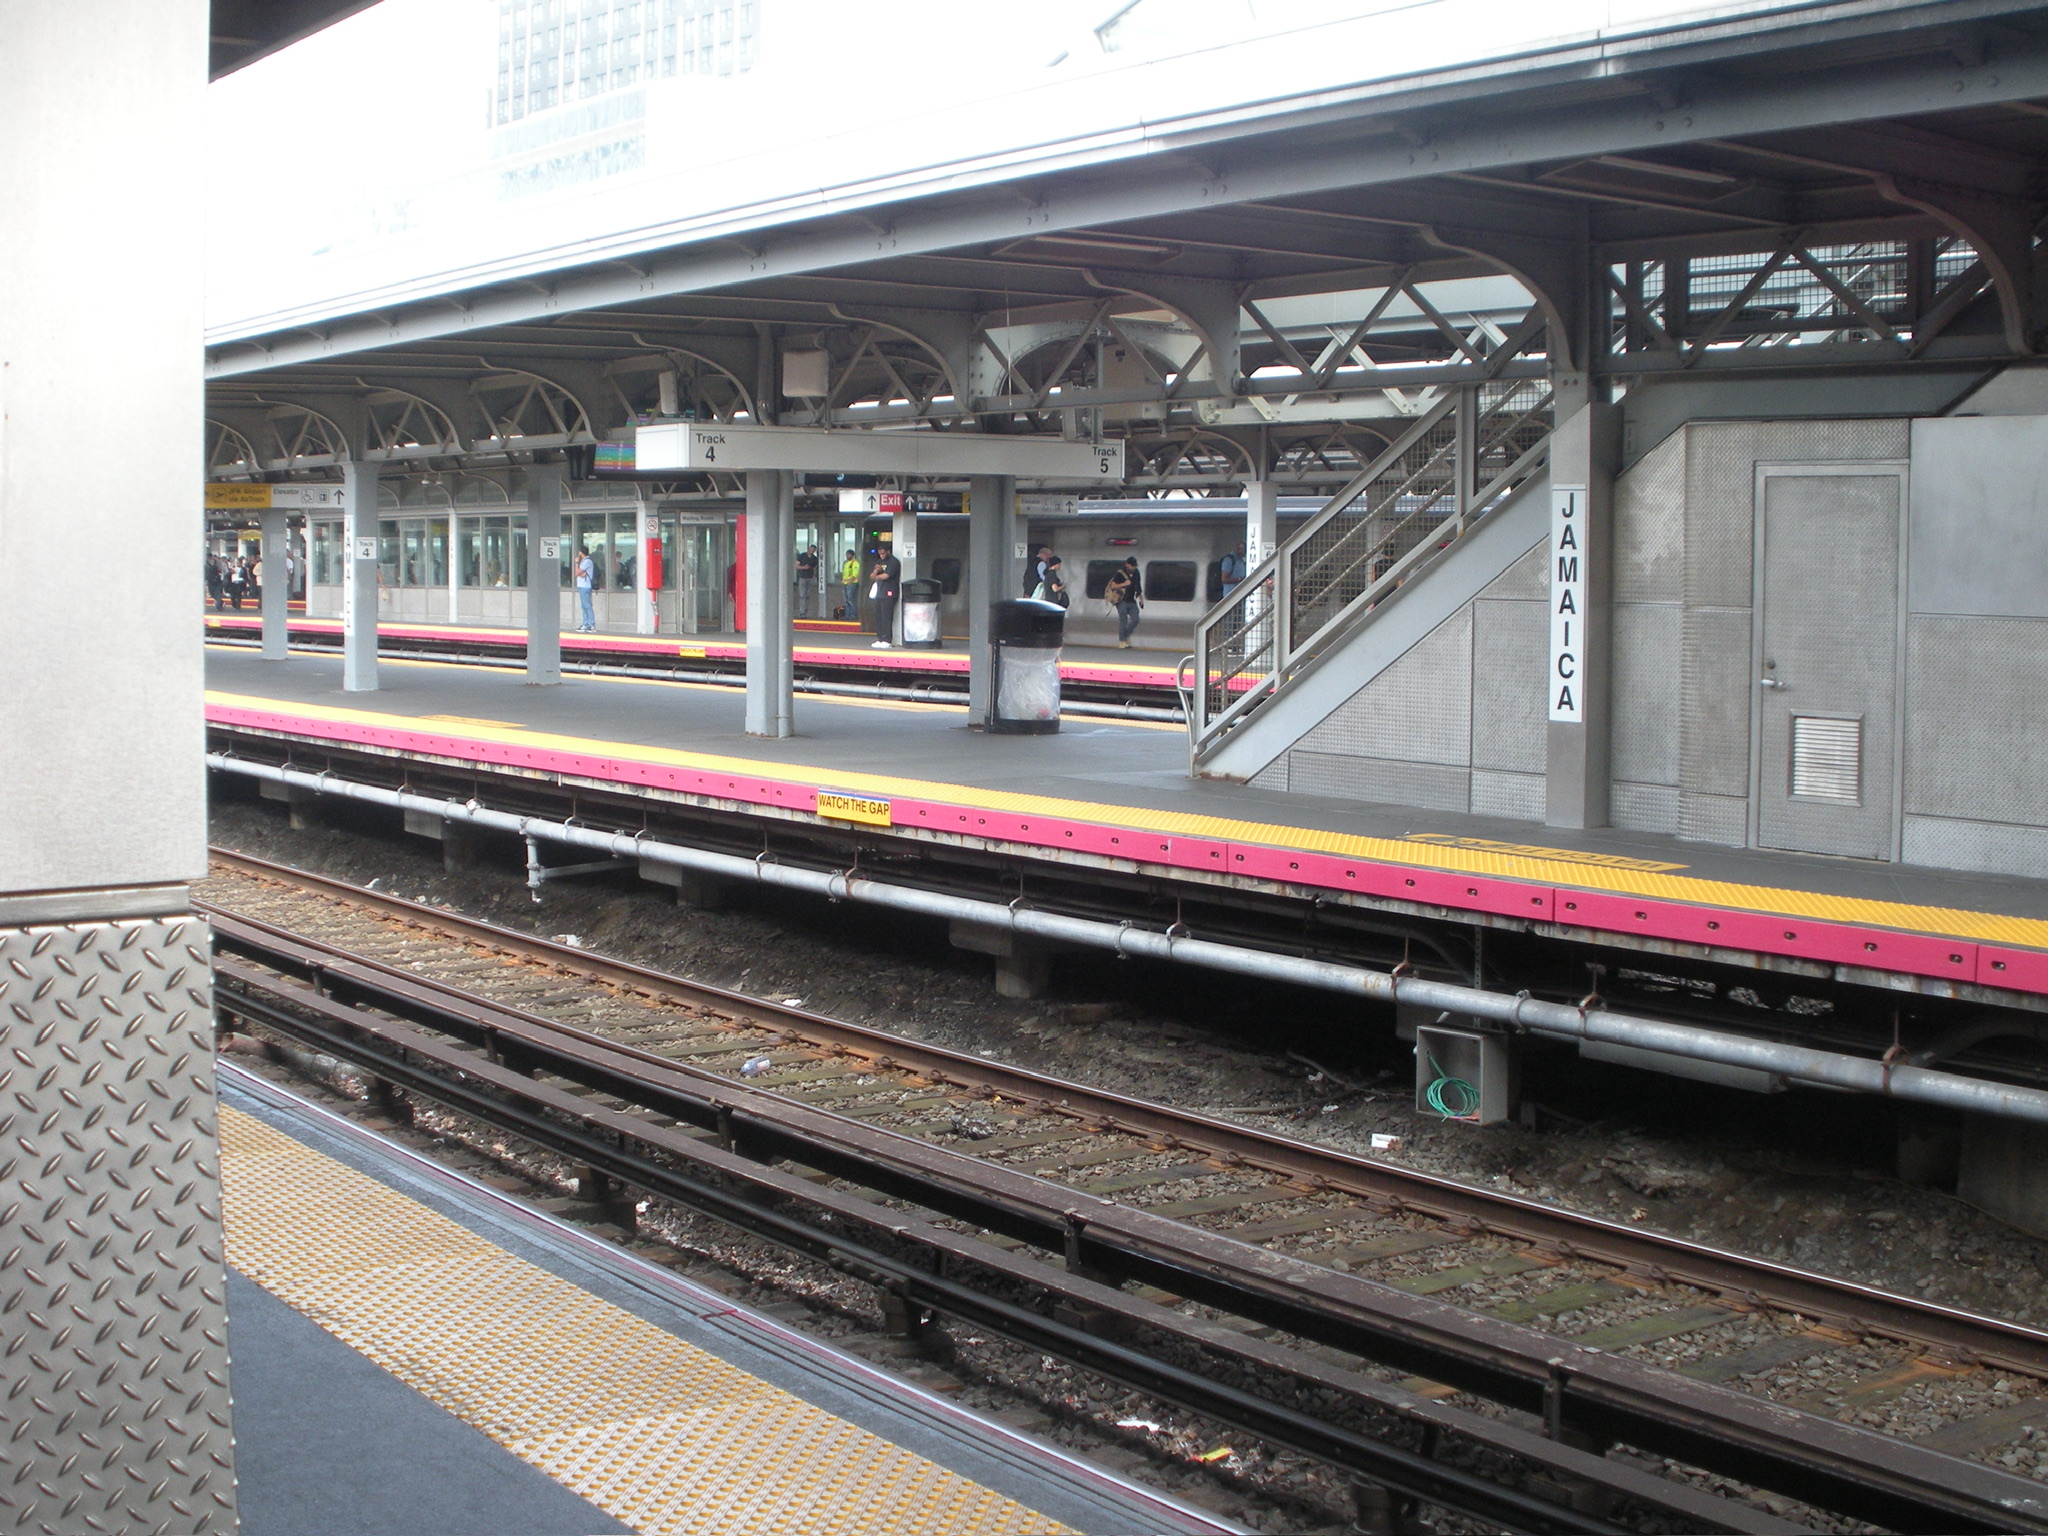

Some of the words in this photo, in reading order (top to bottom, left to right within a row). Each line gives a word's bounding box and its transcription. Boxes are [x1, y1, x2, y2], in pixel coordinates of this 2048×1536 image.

[695, 433, 726, 444] Track
[705, 446, 715, 462] 4
[1092, 446, 1117, 456] Track
[1100, 458, 1109, 474] 5
[881, 494, 900, 506] Exit
[363, 548, 370, 557] 4
[546, 547, 553, 557] 5
[1556, 492, 1578, 711] JAMAICA
[819, 794, 849, 810] WATCH
[851, 799, 867, 813] THE
[869, 801, 890, 815] GAP
